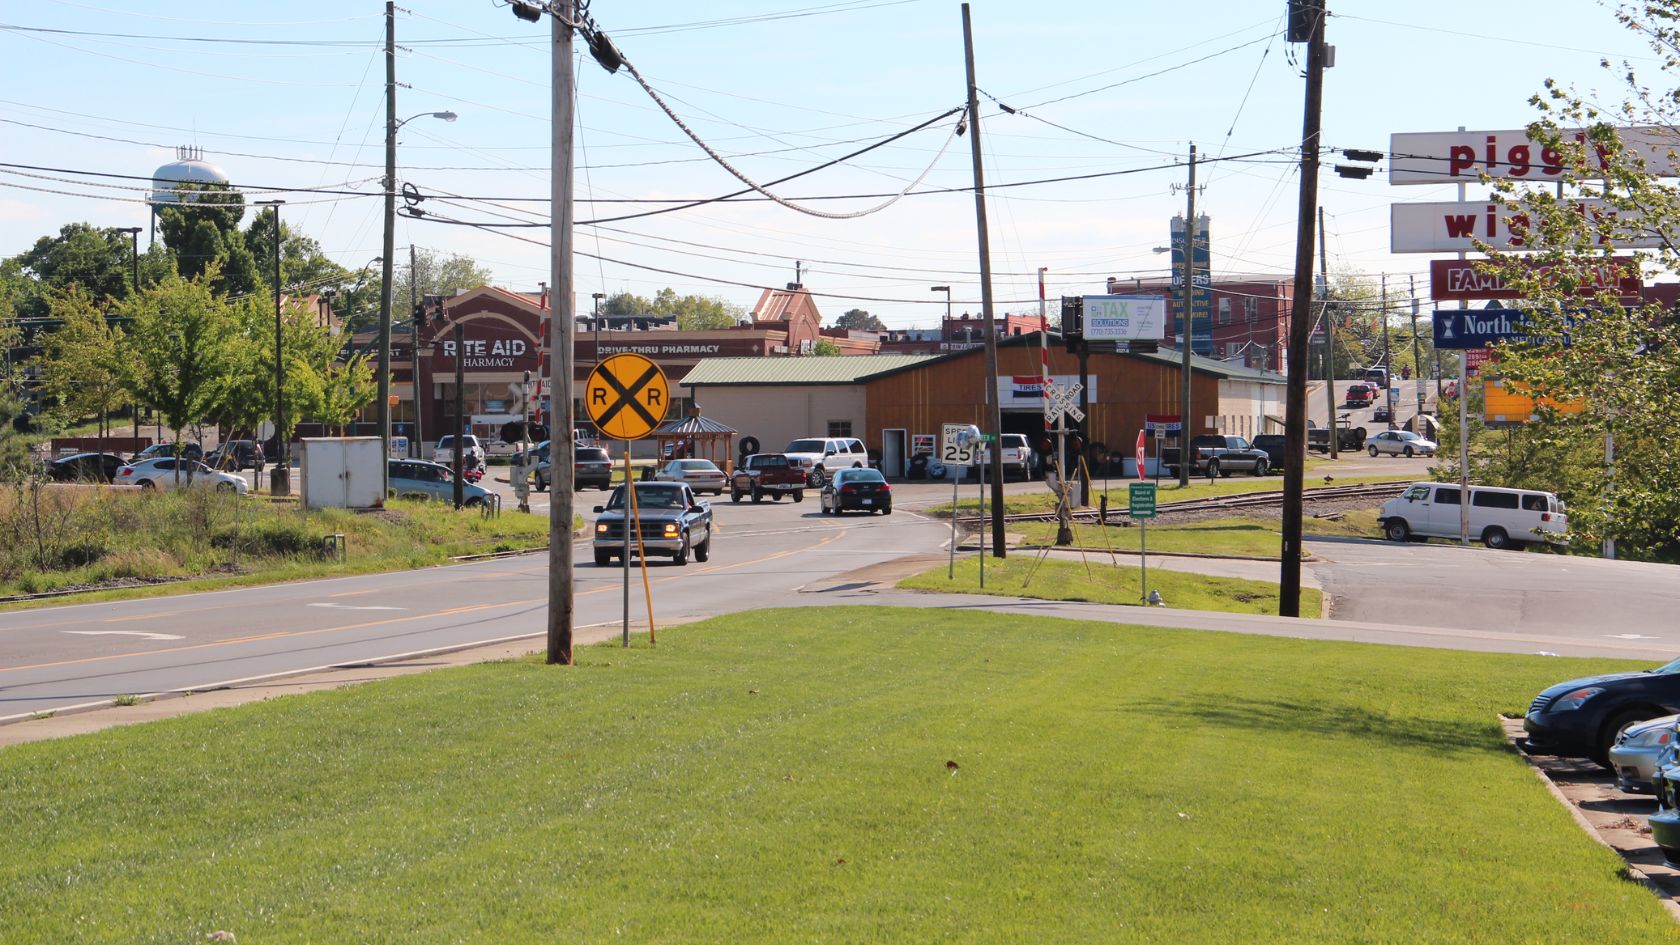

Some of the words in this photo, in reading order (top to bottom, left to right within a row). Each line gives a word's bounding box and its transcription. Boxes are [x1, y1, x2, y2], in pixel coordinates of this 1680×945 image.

[1173, 274, 1209, 286] OFERS
[1102, 301, 1129, 318] TAX
[1091, 319, 1129, 327] SOLUTIONS
[444, 340, 487, 357] RTE
[491, 339, 526, 356] AID
[597, 345, 659, 355] DRIVE-THRU
[662, 343, 719, 353] PHARMACY
[463, 357, 514, 367] HARMACY
[592, 387, 607, 405] R
[647, 388, 661, 406] R
[1045, 385, 1082, 421] CROSSING
[1046, 383, 1081, 421] RAILROAD
[945, 446, 970, 462] 25
[1137, 447, 1145, 465] ST
